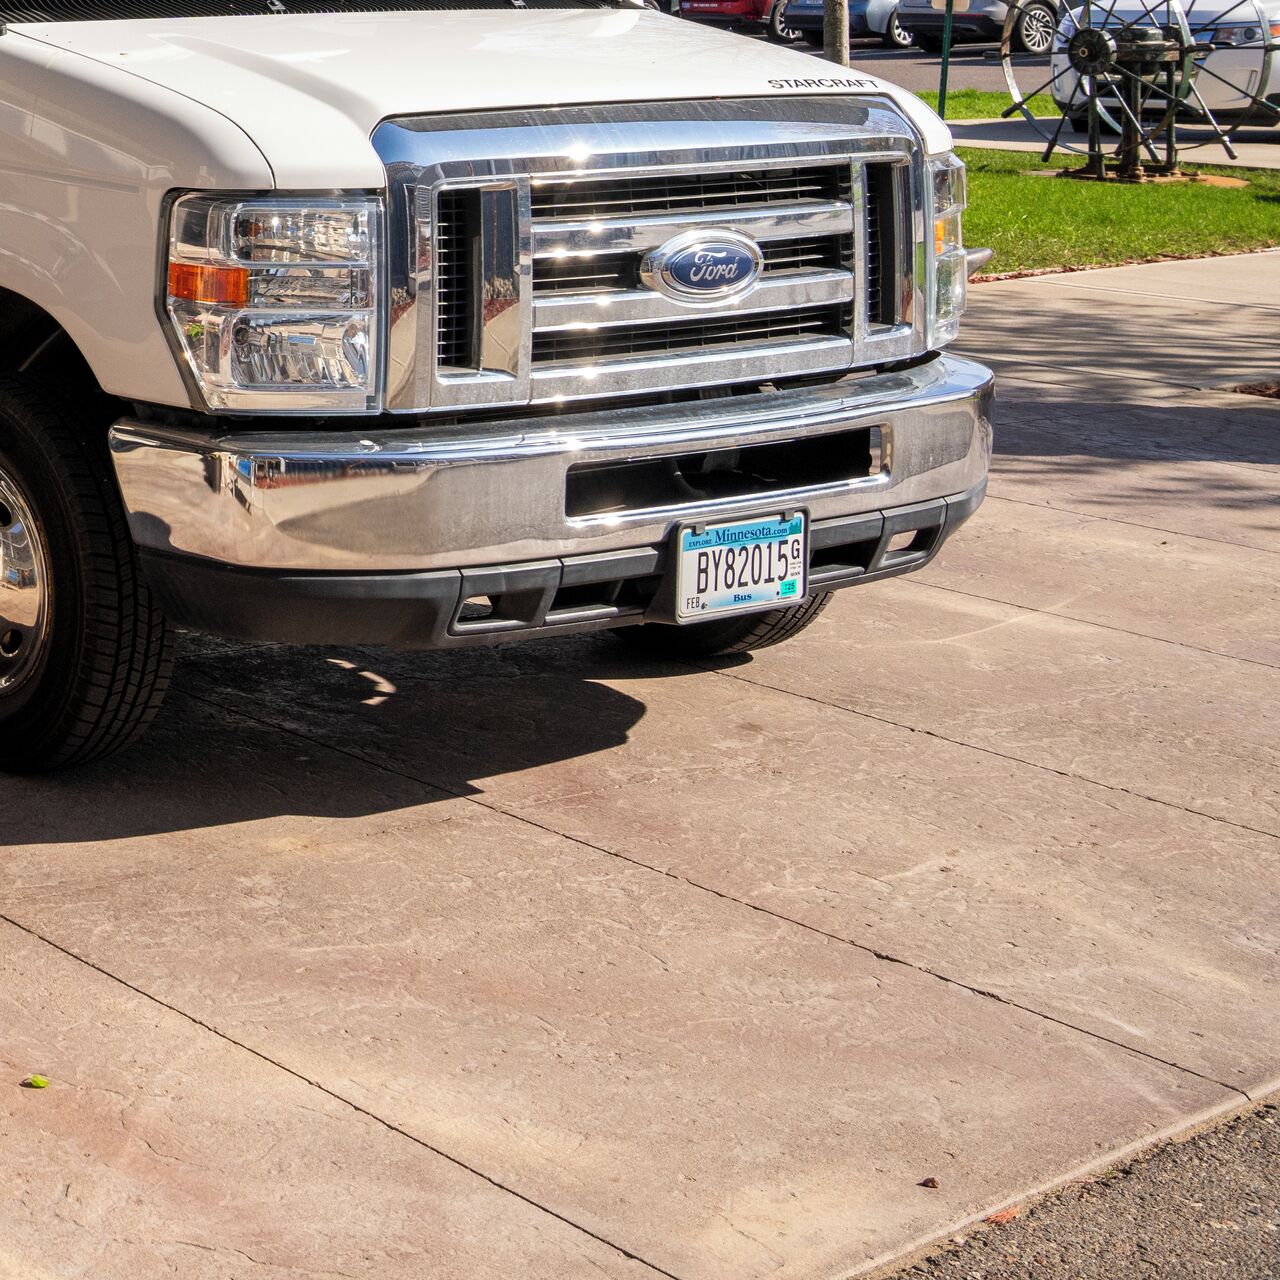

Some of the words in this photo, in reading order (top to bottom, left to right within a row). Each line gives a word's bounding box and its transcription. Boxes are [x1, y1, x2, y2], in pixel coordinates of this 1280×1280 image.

[767, 78, 880, 90] STARCRAFT
[690, 251, 739, 282] Ford
[715, 525, 788, 543] Minnesota.com
[697, 540, 788, 594] BY82015
[791, 538, 801, 560] G
[686, 596, 700, 610] FEB
[733, 593, 753, 603] Bus
